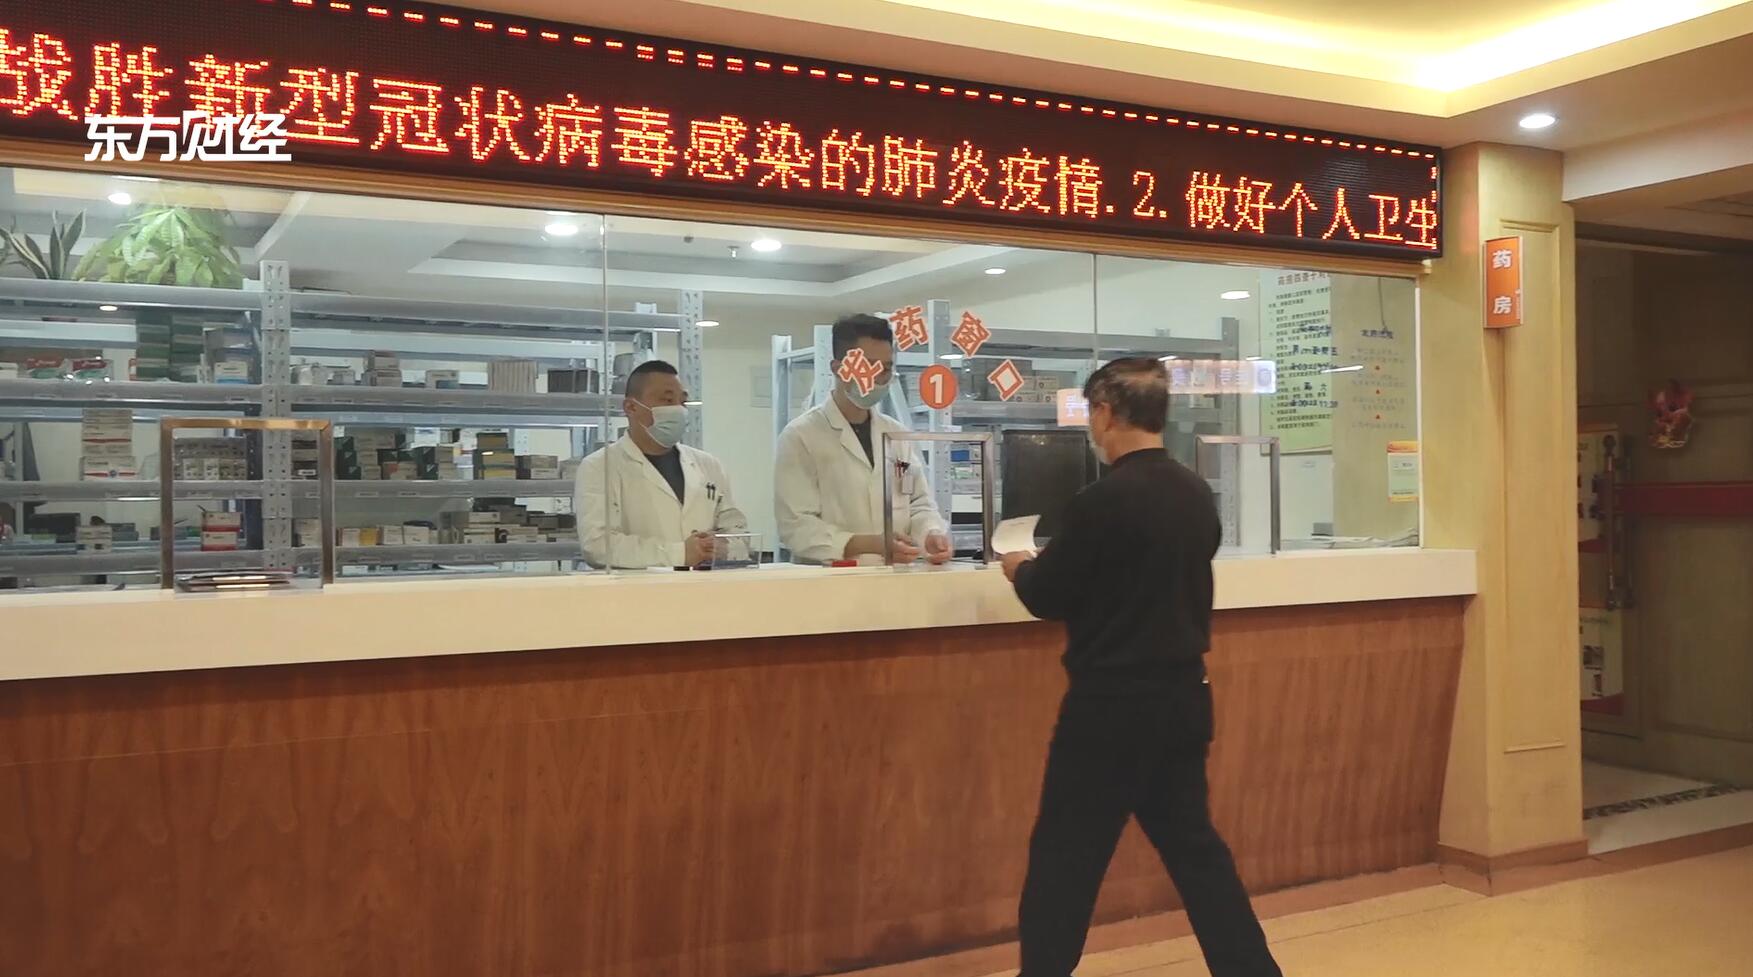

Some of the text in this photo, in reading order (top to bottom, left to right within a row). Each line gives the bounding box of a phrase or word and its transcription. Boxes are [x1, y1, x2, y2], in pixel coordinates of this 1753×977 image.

[1492, 249, 1512, 314] 药房
[837, 304, 1025, 400] 发药窗口
